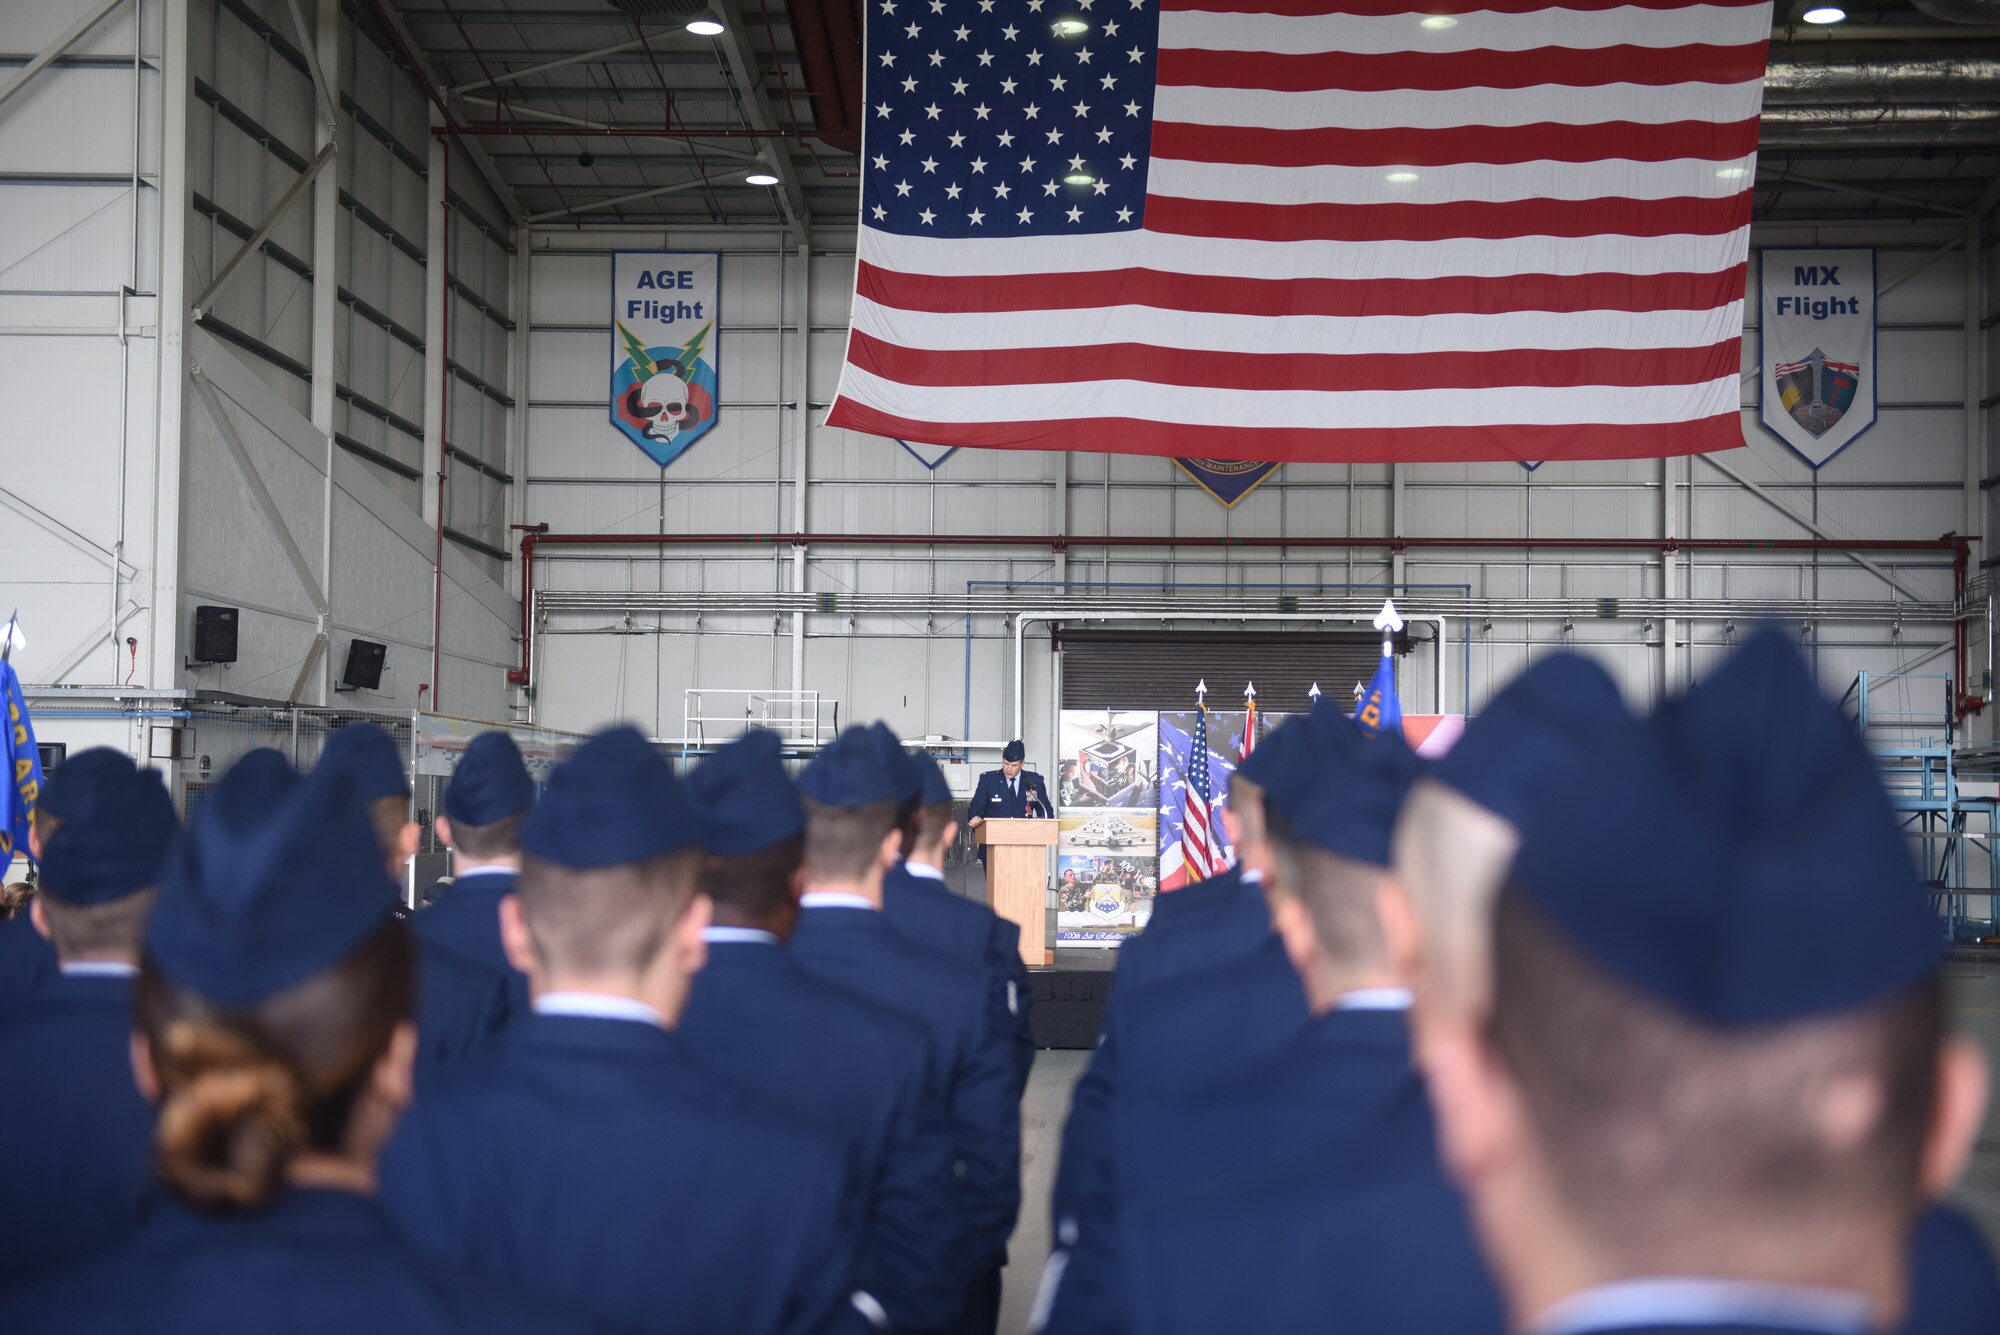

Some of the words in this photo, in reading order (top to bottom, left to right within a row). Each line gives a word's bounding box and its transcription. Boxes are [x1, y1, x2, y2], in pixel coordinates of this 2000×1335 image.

[636, 270, 694, 289] AGE
[1794, 266, 1841, 286] MX
[627, 300, 704, 324] Flight
[1776, 296, 1860, 321] Flight
[1205, 460, 1260, 472] MAINTENANCE
[1063, 931, 1081, 940] 100th
[1081, 932, 1095, 940] Air
